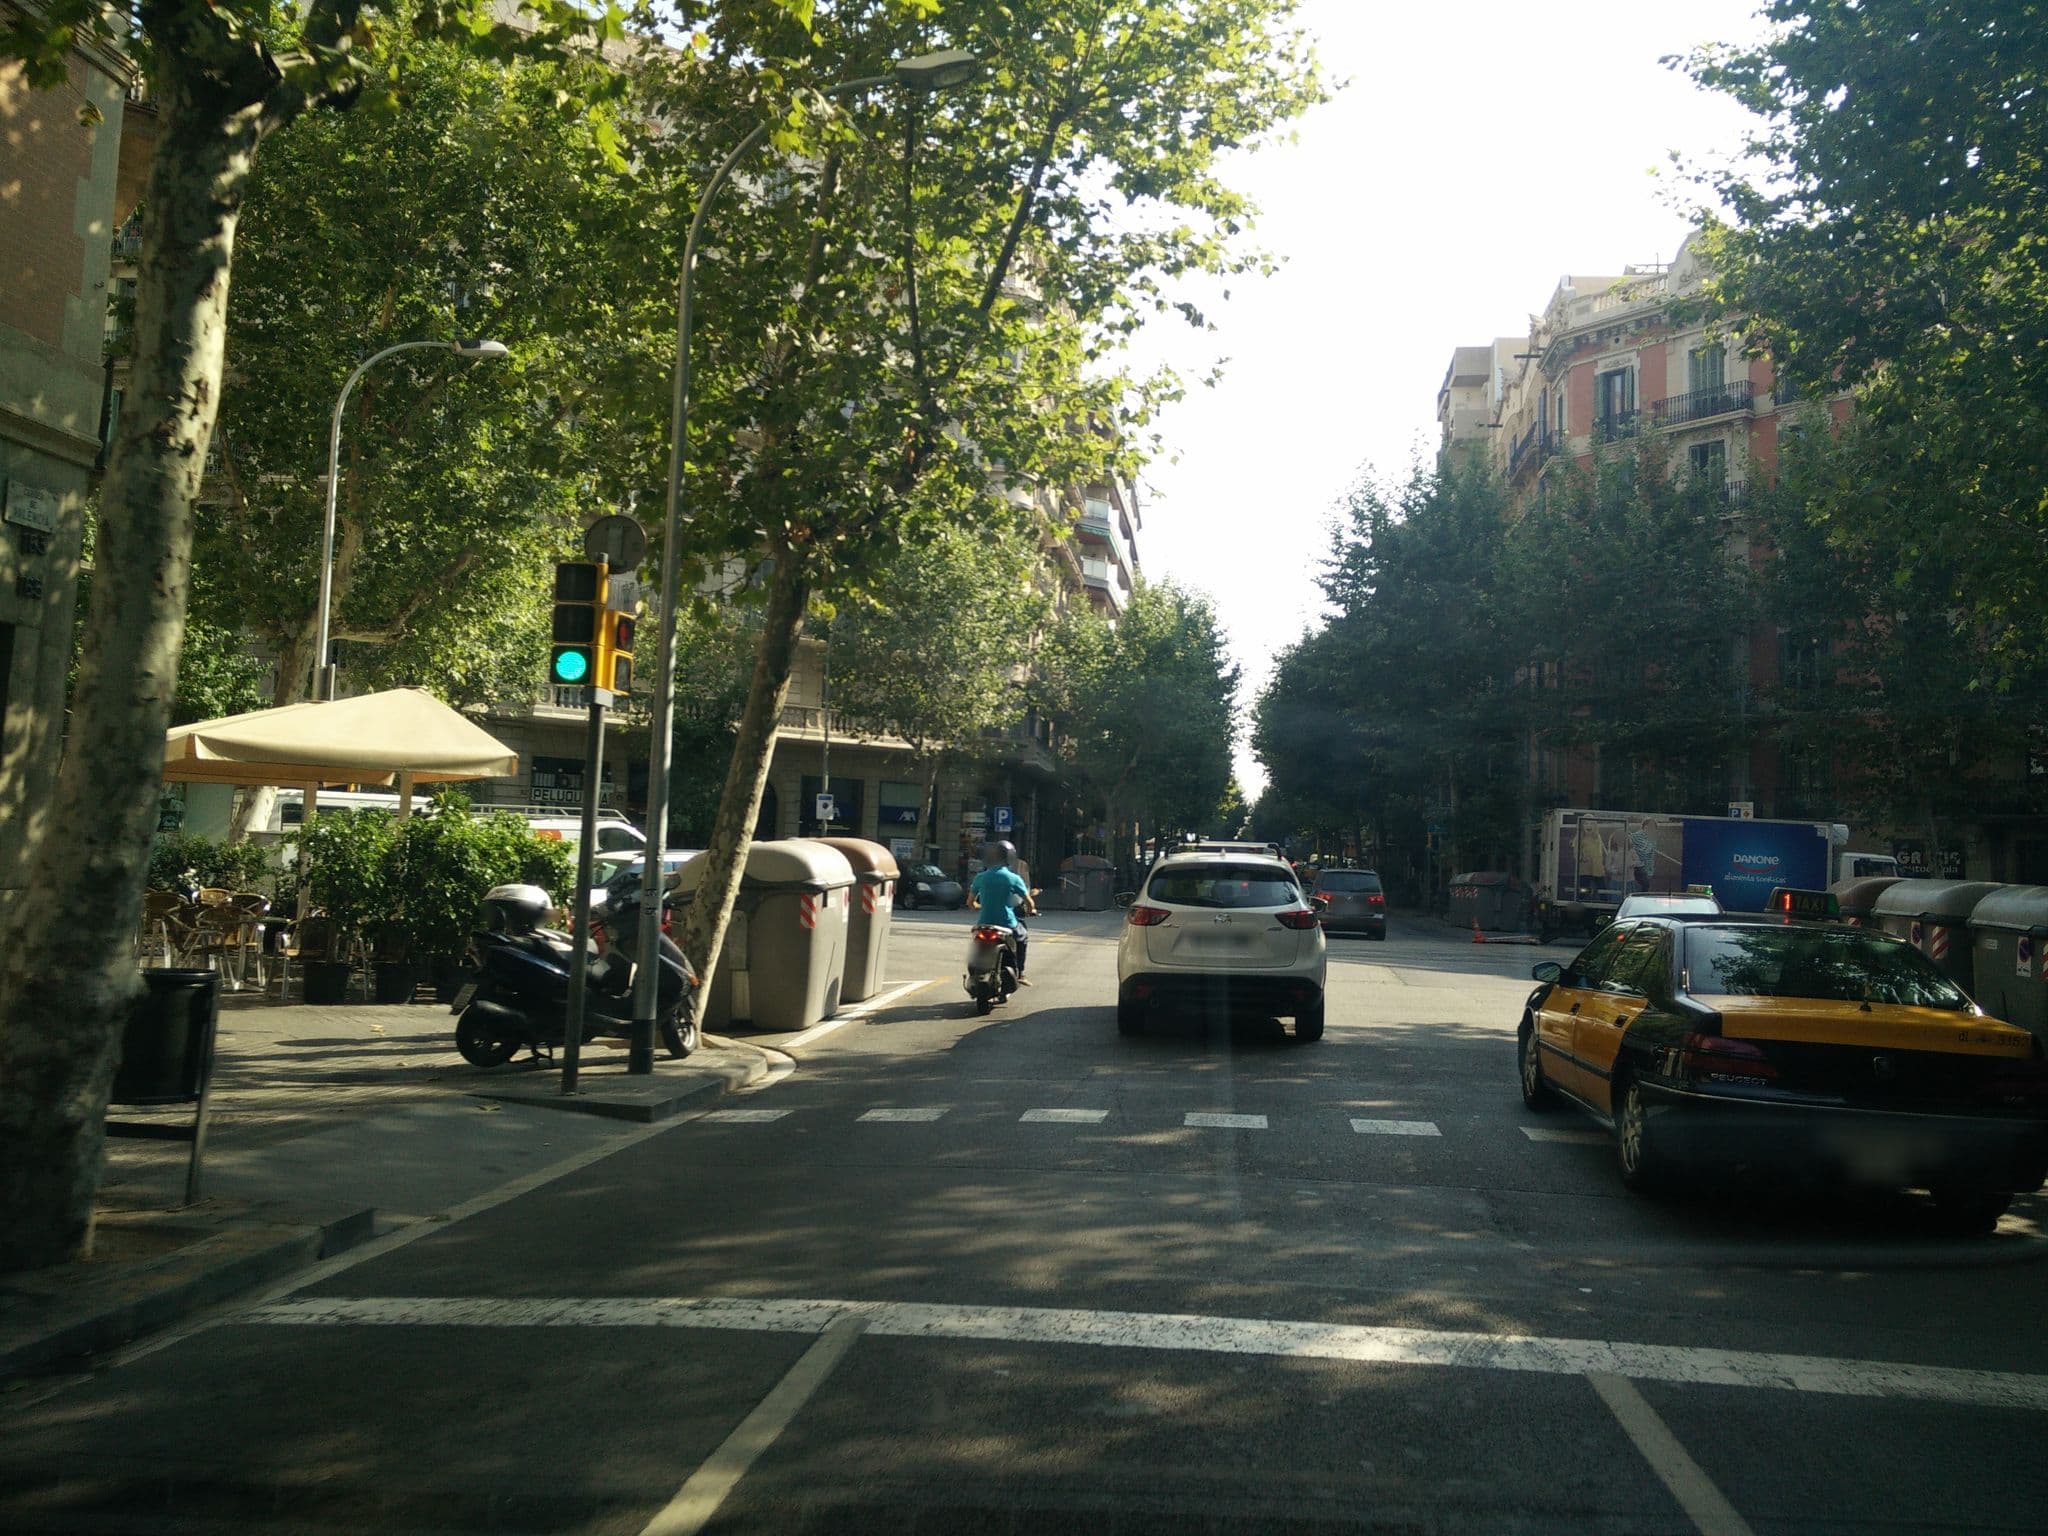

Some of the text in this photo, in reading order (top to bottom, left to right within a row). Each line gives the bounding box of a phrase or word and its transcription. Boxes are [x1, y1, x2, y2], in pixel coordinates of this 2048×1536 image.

[998, 809, 1009, 824] P
[1733, 854, 1780, 865] DANONE
[1795, 894, 1825, 911] TAXI
[1710, 1072, 1768, 1086] PEUGEOT
